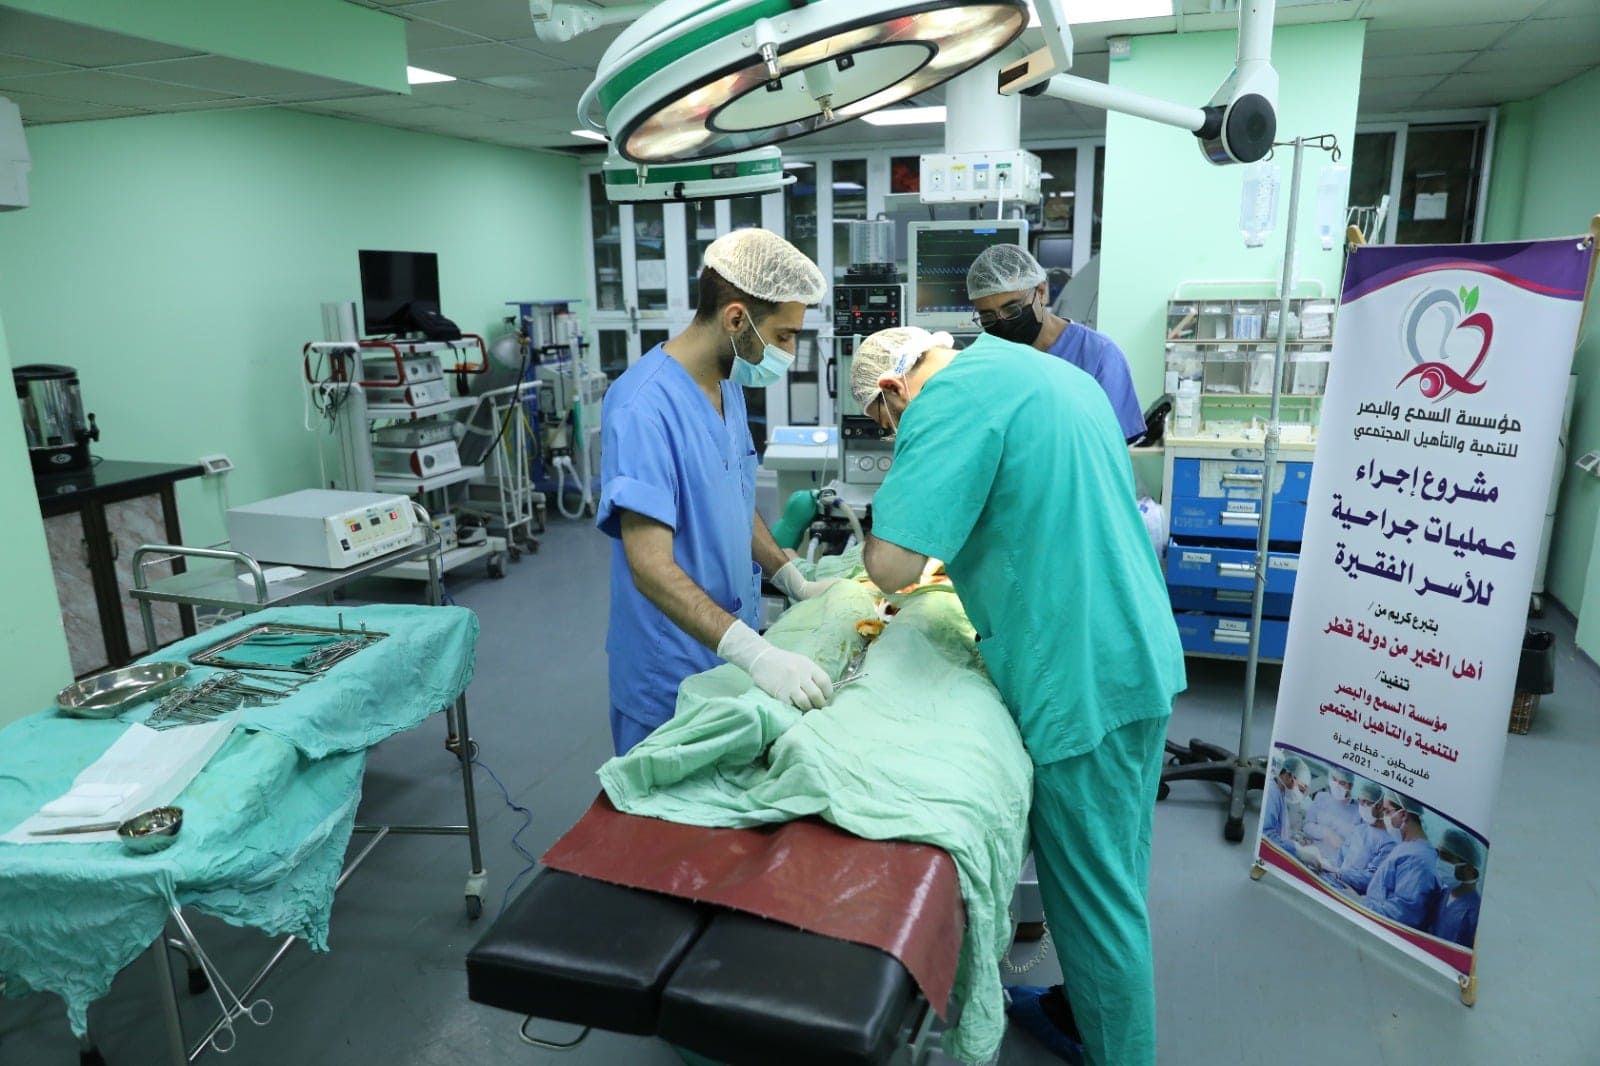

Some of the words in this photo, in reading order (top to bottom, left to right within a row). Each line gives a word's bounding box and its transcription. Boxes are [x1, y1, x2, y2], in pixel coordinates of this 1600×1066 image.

[1357, 400, 1400, 420] والبصر
[1404, 406, 1451, 423] السمع
[1455, 409, 1522, 435] مؤسسة
[1353, 425, 1410, 442] المجتمعي
[1414, 430, 1465, 453] والتأهيل
[1469, 438, 1519, 457] للتنمية
[1355, 458, 1419, 497] إجراء
[1421, 471, 1499, 504] مشروع
[1331, 493, 1419, 544] جراحية
[1424, 516, 1517, 560] عمليات
[1334, 542, 1414, 585] الفقيرة
[1414, 571, 1494, 606] للأسر
[1374, 604, 1387, 618] من
[1388, 611, 1412, 625] كريم
[1324, 616, 1354, 638] قطر
[1357, 621, 1387, 650] دولة
[1412, 616, 1439, 636] بتبرع
[1388, 638, 1408, 658] من
[1410, 648, 1450, 669] الخير
[1452, 658, 1484, 681] أهل
[1334, 684, 1372, 706] والبصر
[1372, 696, 1406, 715] السمع
[1319, 702, 1362, 723] المجتمعي
[1408, 704, 1448, 733] مؤسسة
[1333, 732, 1351, 746] غزة
[1353, 741, 1379, 758] قطاع
[1414, 732, 1459, 763] للتنمية
[1386, 757, 1430, 780] فلسطين
